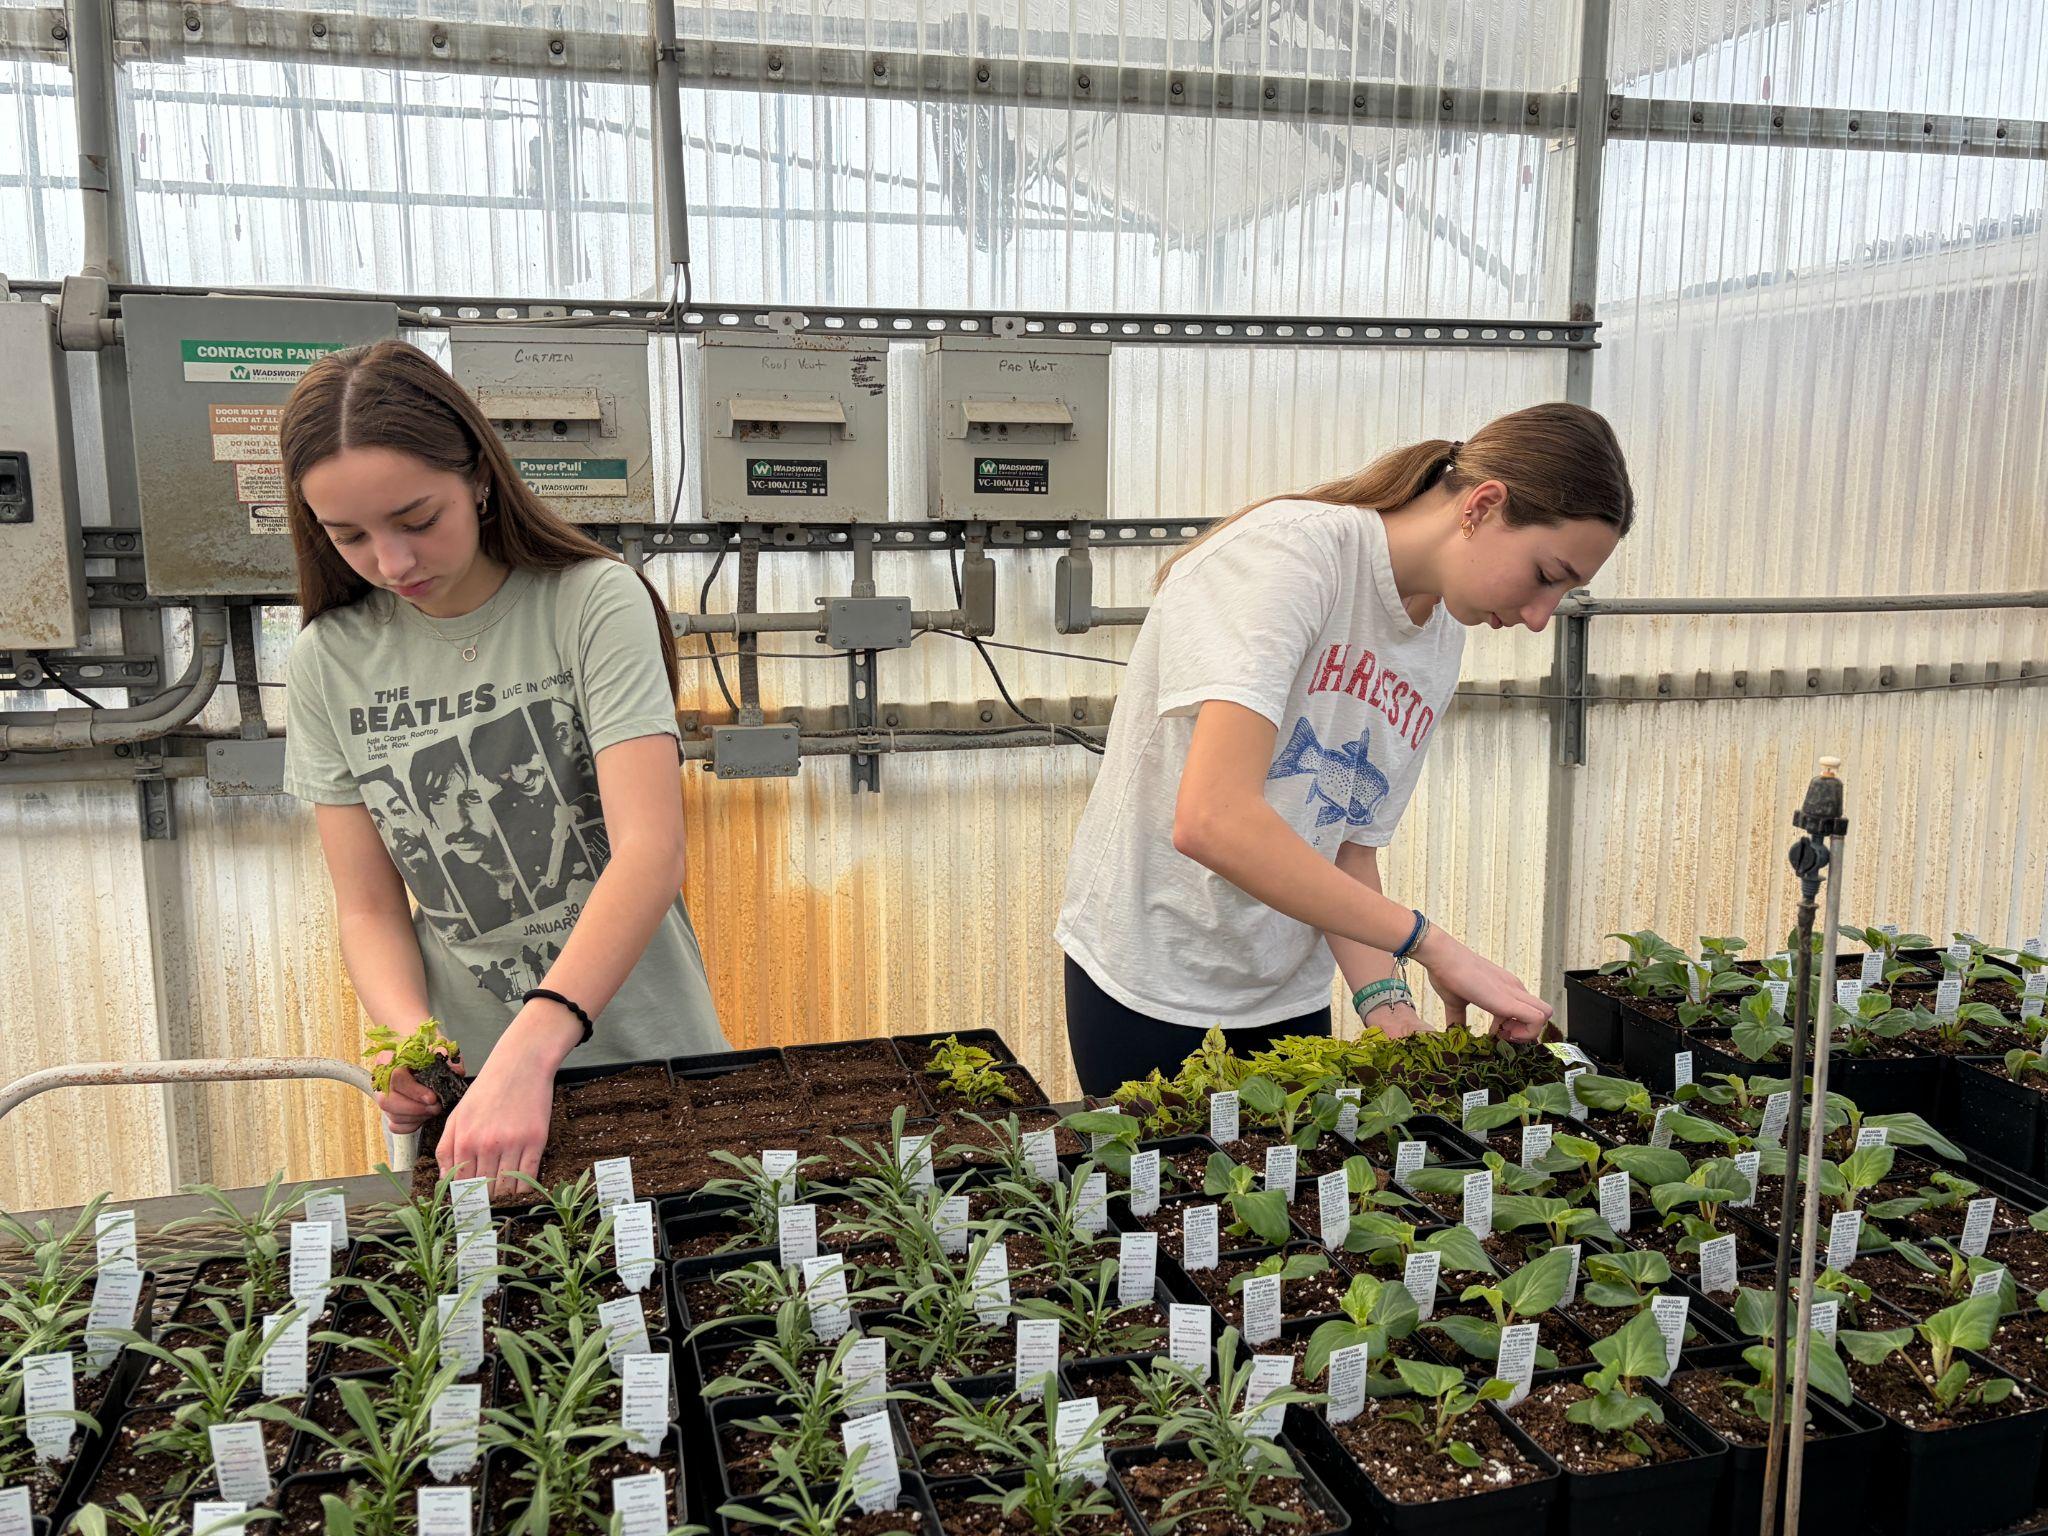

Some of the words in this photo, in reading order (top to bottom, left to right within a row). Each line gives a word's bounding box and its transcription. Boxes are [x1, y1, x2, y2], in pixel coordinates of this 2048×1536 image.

[197, 346, 282, 359] CONTACTOR
[998, 464, 1044, 472] WADSWORTH
[374, 686, 410, 704] THE
[502, 684, 523, 700] LIVE
[526, 682, 538, 693] IN
[350, 682, 496, 736] BEATLES
[384, 734, 406, 743] Corps
[410, 728, 438, 740] Rooftop
[564, 903, 580, 916] 30
